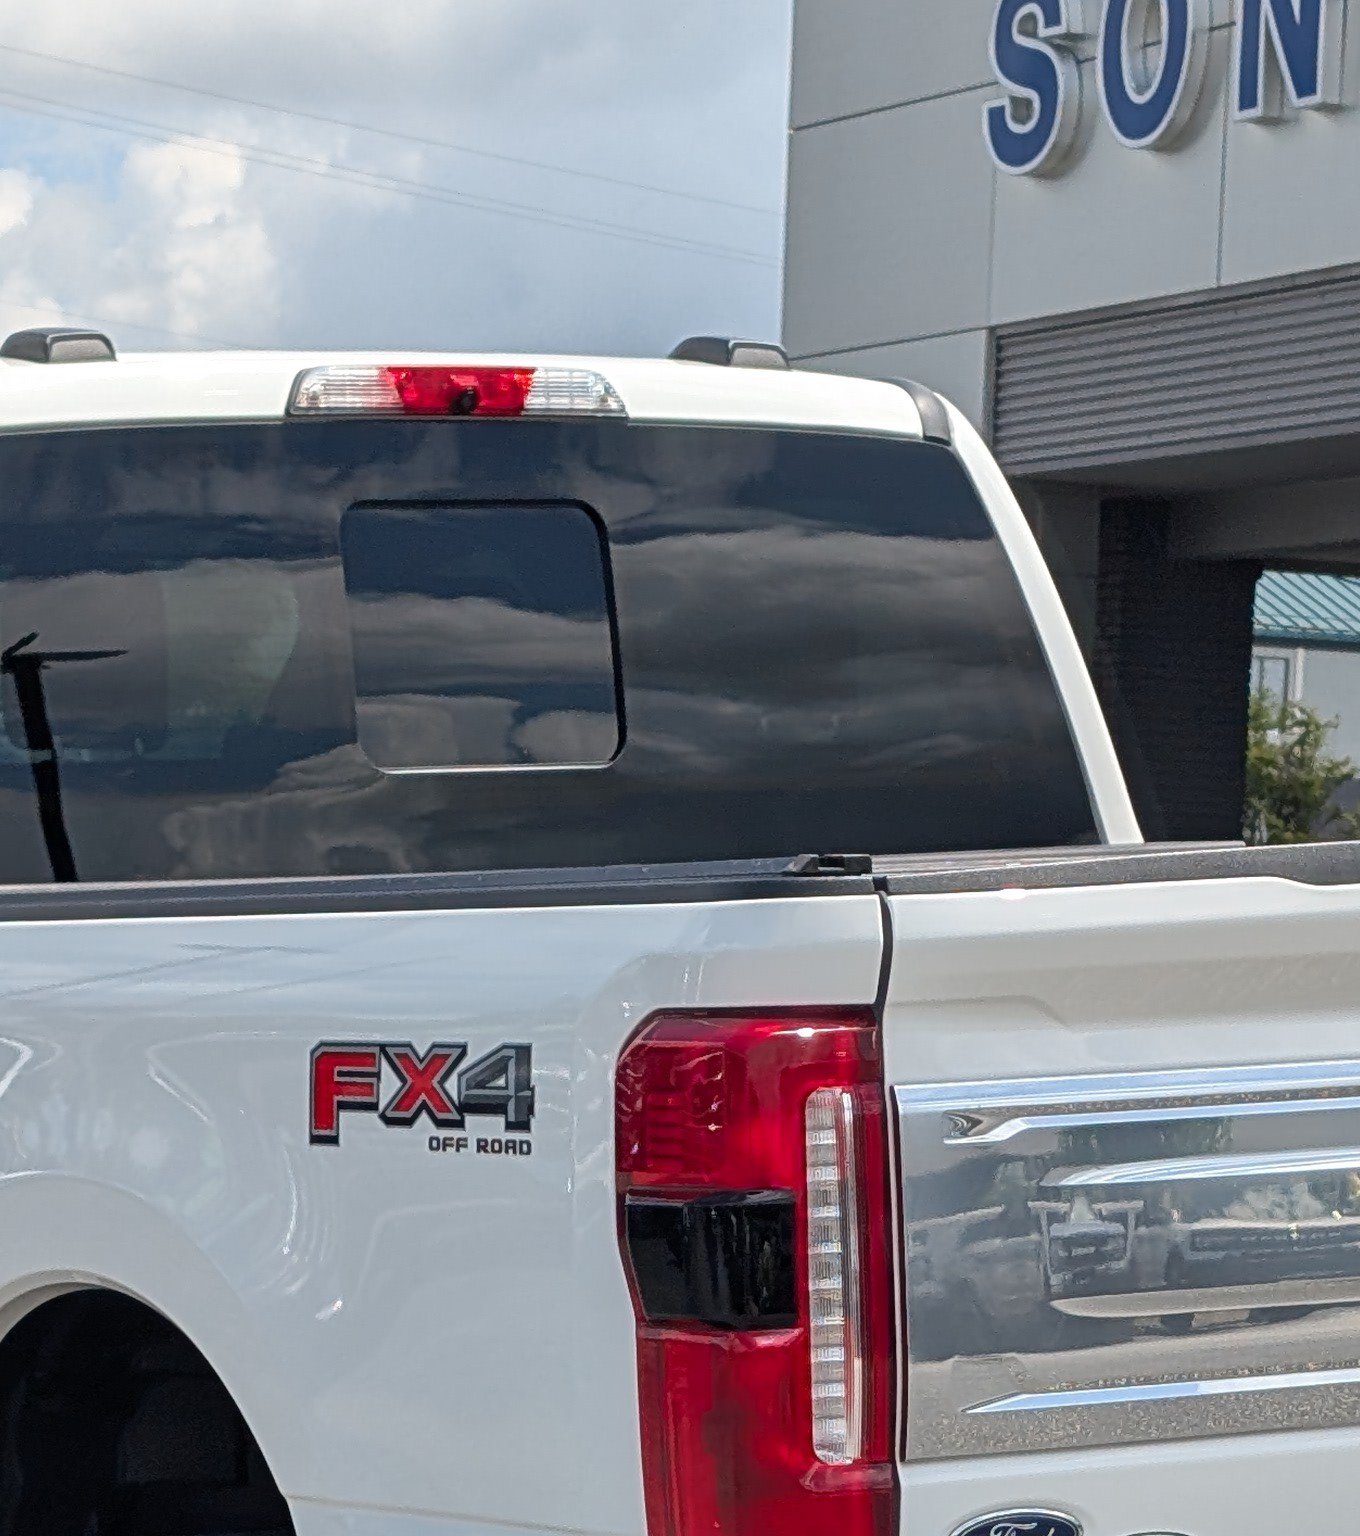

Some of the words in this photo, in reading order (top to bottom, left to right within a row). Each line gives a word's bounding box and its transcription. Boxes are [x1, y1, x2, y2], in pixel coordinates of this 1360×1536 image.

[309, 1041, 535, 1147] FX4
[428, 1136, 469, 1153] OFF
[475, 1138, 532, 1156] ROAD
